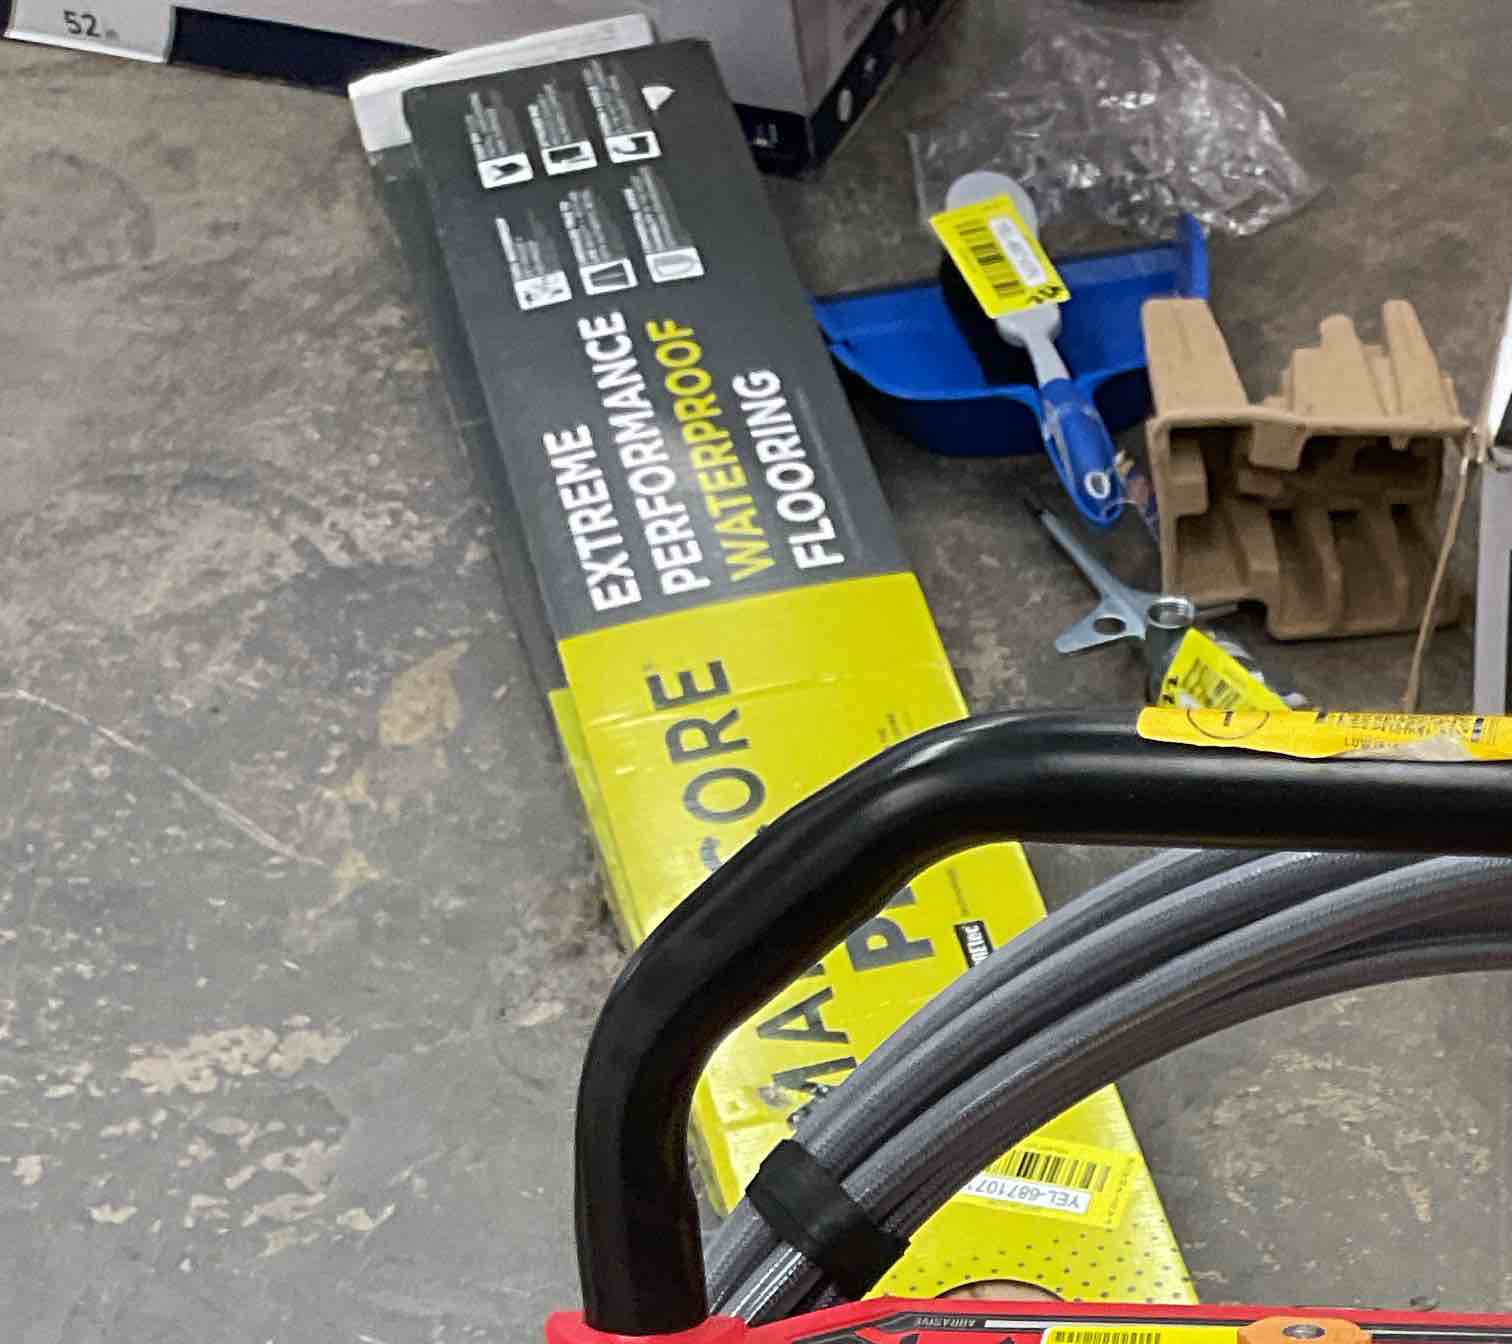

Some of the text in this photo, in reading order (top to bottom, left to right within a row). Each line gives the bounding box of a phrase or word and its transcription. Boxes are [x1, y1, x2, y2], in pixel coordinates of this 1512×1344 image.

[63, 9, 100, 37] 52
[543, 423, 642, 611] EXTREME
[577, 311, 711, 595] PERFORMANCE
[645, 318, 776, 582] WATERPROOF
[732, 368, 845, 569] FLOORING
